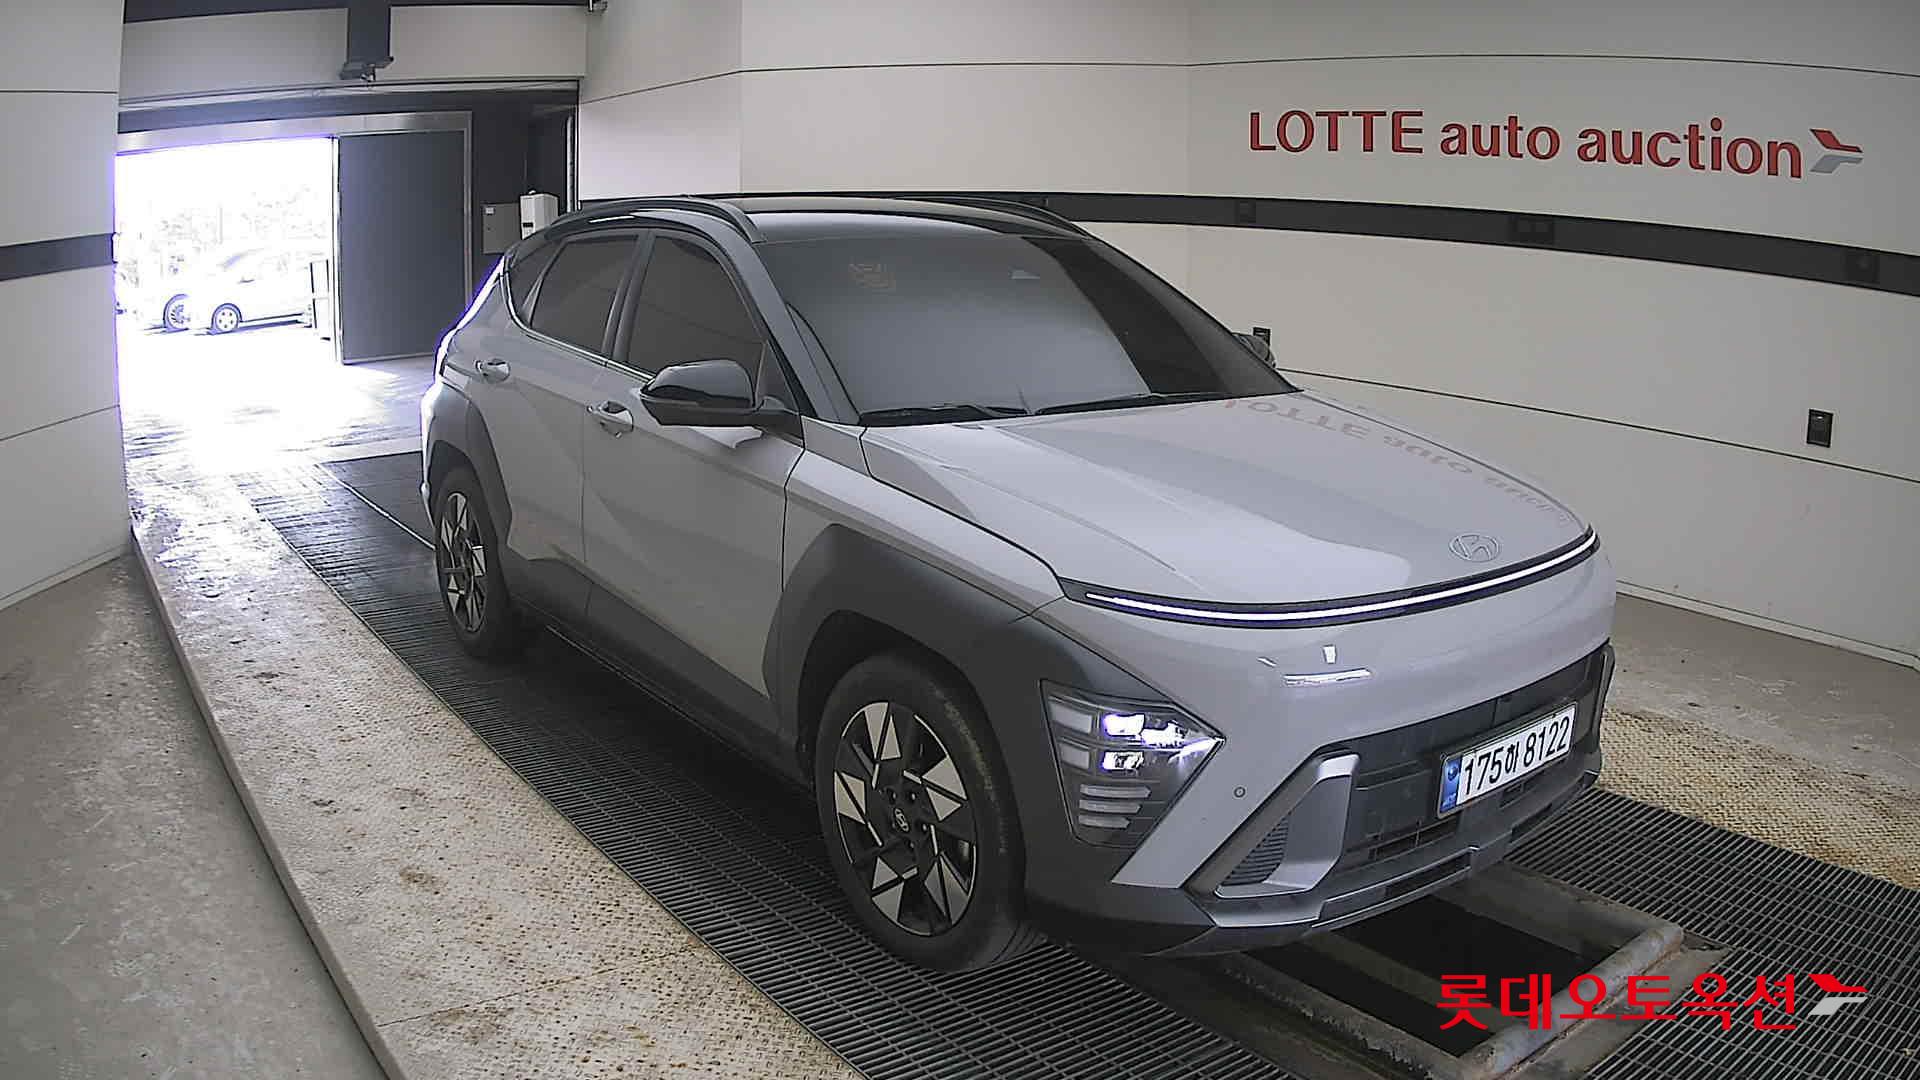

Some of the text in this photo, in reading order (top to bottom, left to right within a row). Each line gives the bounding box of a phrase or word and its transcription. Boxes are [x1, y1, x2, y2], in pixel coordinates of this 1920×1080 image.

[1249, 110, 1802, 179] LOTTE auto auction
[1523, 716, 1570, 767] 8122
